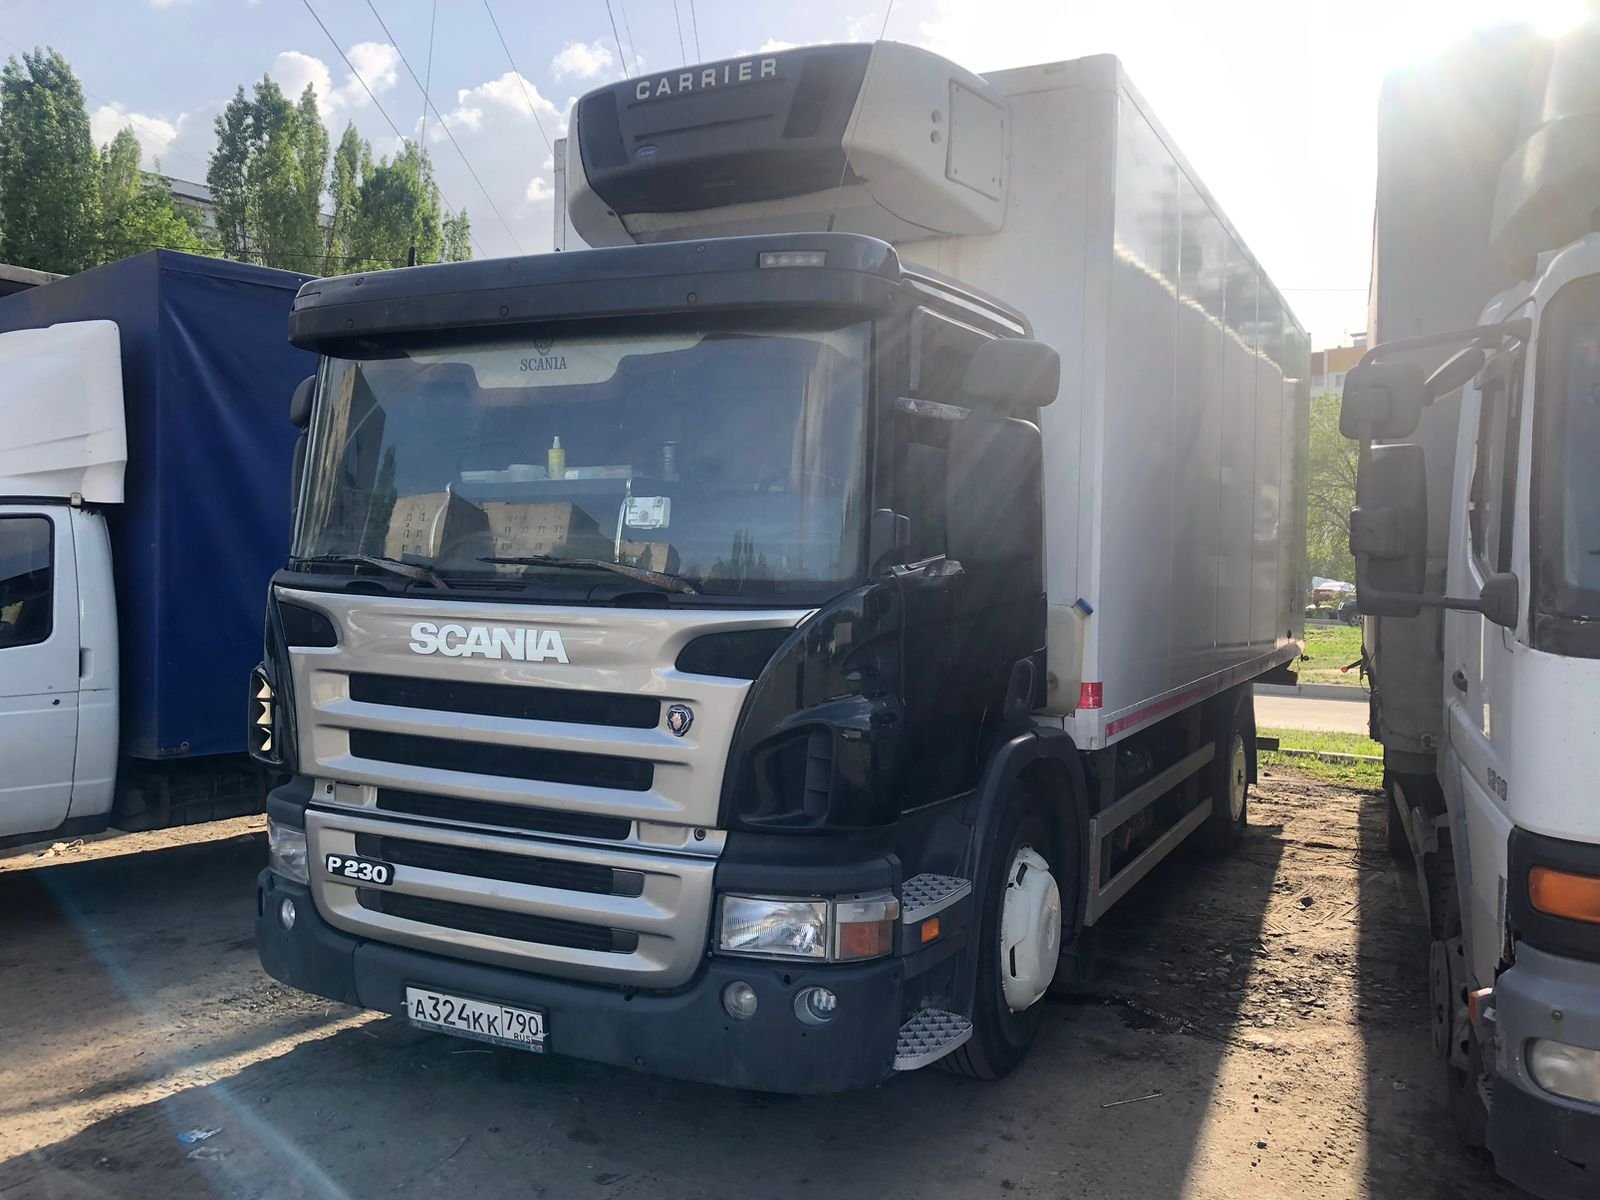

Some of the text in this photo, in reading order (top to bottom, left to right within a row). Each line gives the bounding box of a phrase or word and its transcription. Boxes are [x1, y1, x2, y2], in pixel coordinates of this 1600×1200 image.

[636, 58, 776, 100] CARRIER
[520, 356, 567, 371] SCANIA
[409, 622, 570, 664] SCANIA
[328, 856, 388, 883] P 230
